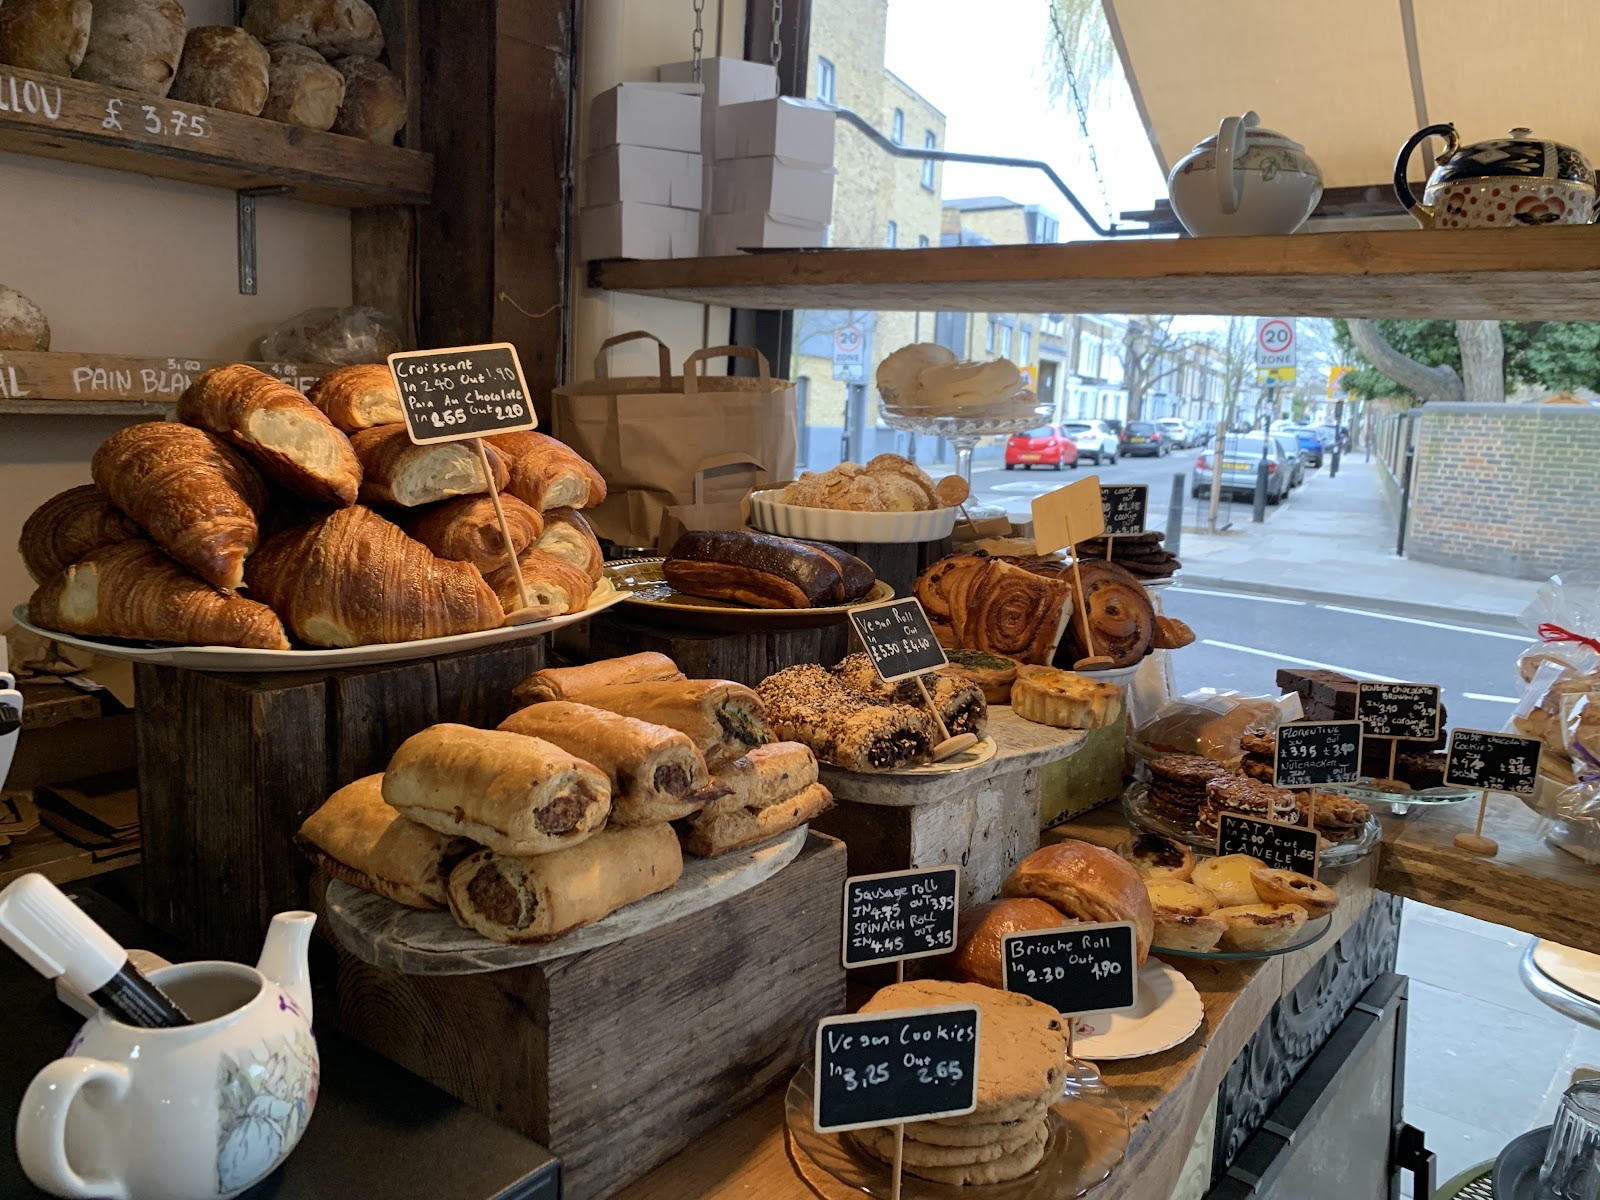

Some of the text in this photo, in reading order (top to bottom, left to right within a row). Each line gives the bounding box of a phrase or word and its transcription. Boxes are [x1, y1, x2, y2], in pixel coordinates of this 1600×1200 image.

[102, 98, 123, 131] £
[840, 332, 858, 344] 20
[1265, 329, 1288, 343] 20
[396, 359, 473, 378] Croissant
[1260, 355, 1291, 365] ZONE
[72, 367, 132, 397] PAIN
[421, 378, 455, 392] 2.40
[460, 374, 485, 385] Out
[408, 396, 434, 410] Pain
[444, 394, 459, 407] Au
[494, 403, 524, 420] 2.20
[856, 607, 914, 634] Vegan Roll
[1226, 818, 1275, 837] NATA
[1224, 840, 1292, 864] CANELE
[852, 903, 872, 918] IN
[870, 903, 901, 922] 4.75
[852, 936, 872, 947] IN
[870, 937, 904, 954] 4.45
[1010, 935, 1111, 959] Brioche Roll
[1011, 961, 1025, 973] In
[1026, 966, 1065, 983] 2.30
[1068, 953, 1095, 965] Out
[827, 1024, 975, 1054] Vegan Cookies
[829, 1061, 843, 1077] In
[903, 1052, 932, 1068] Out
